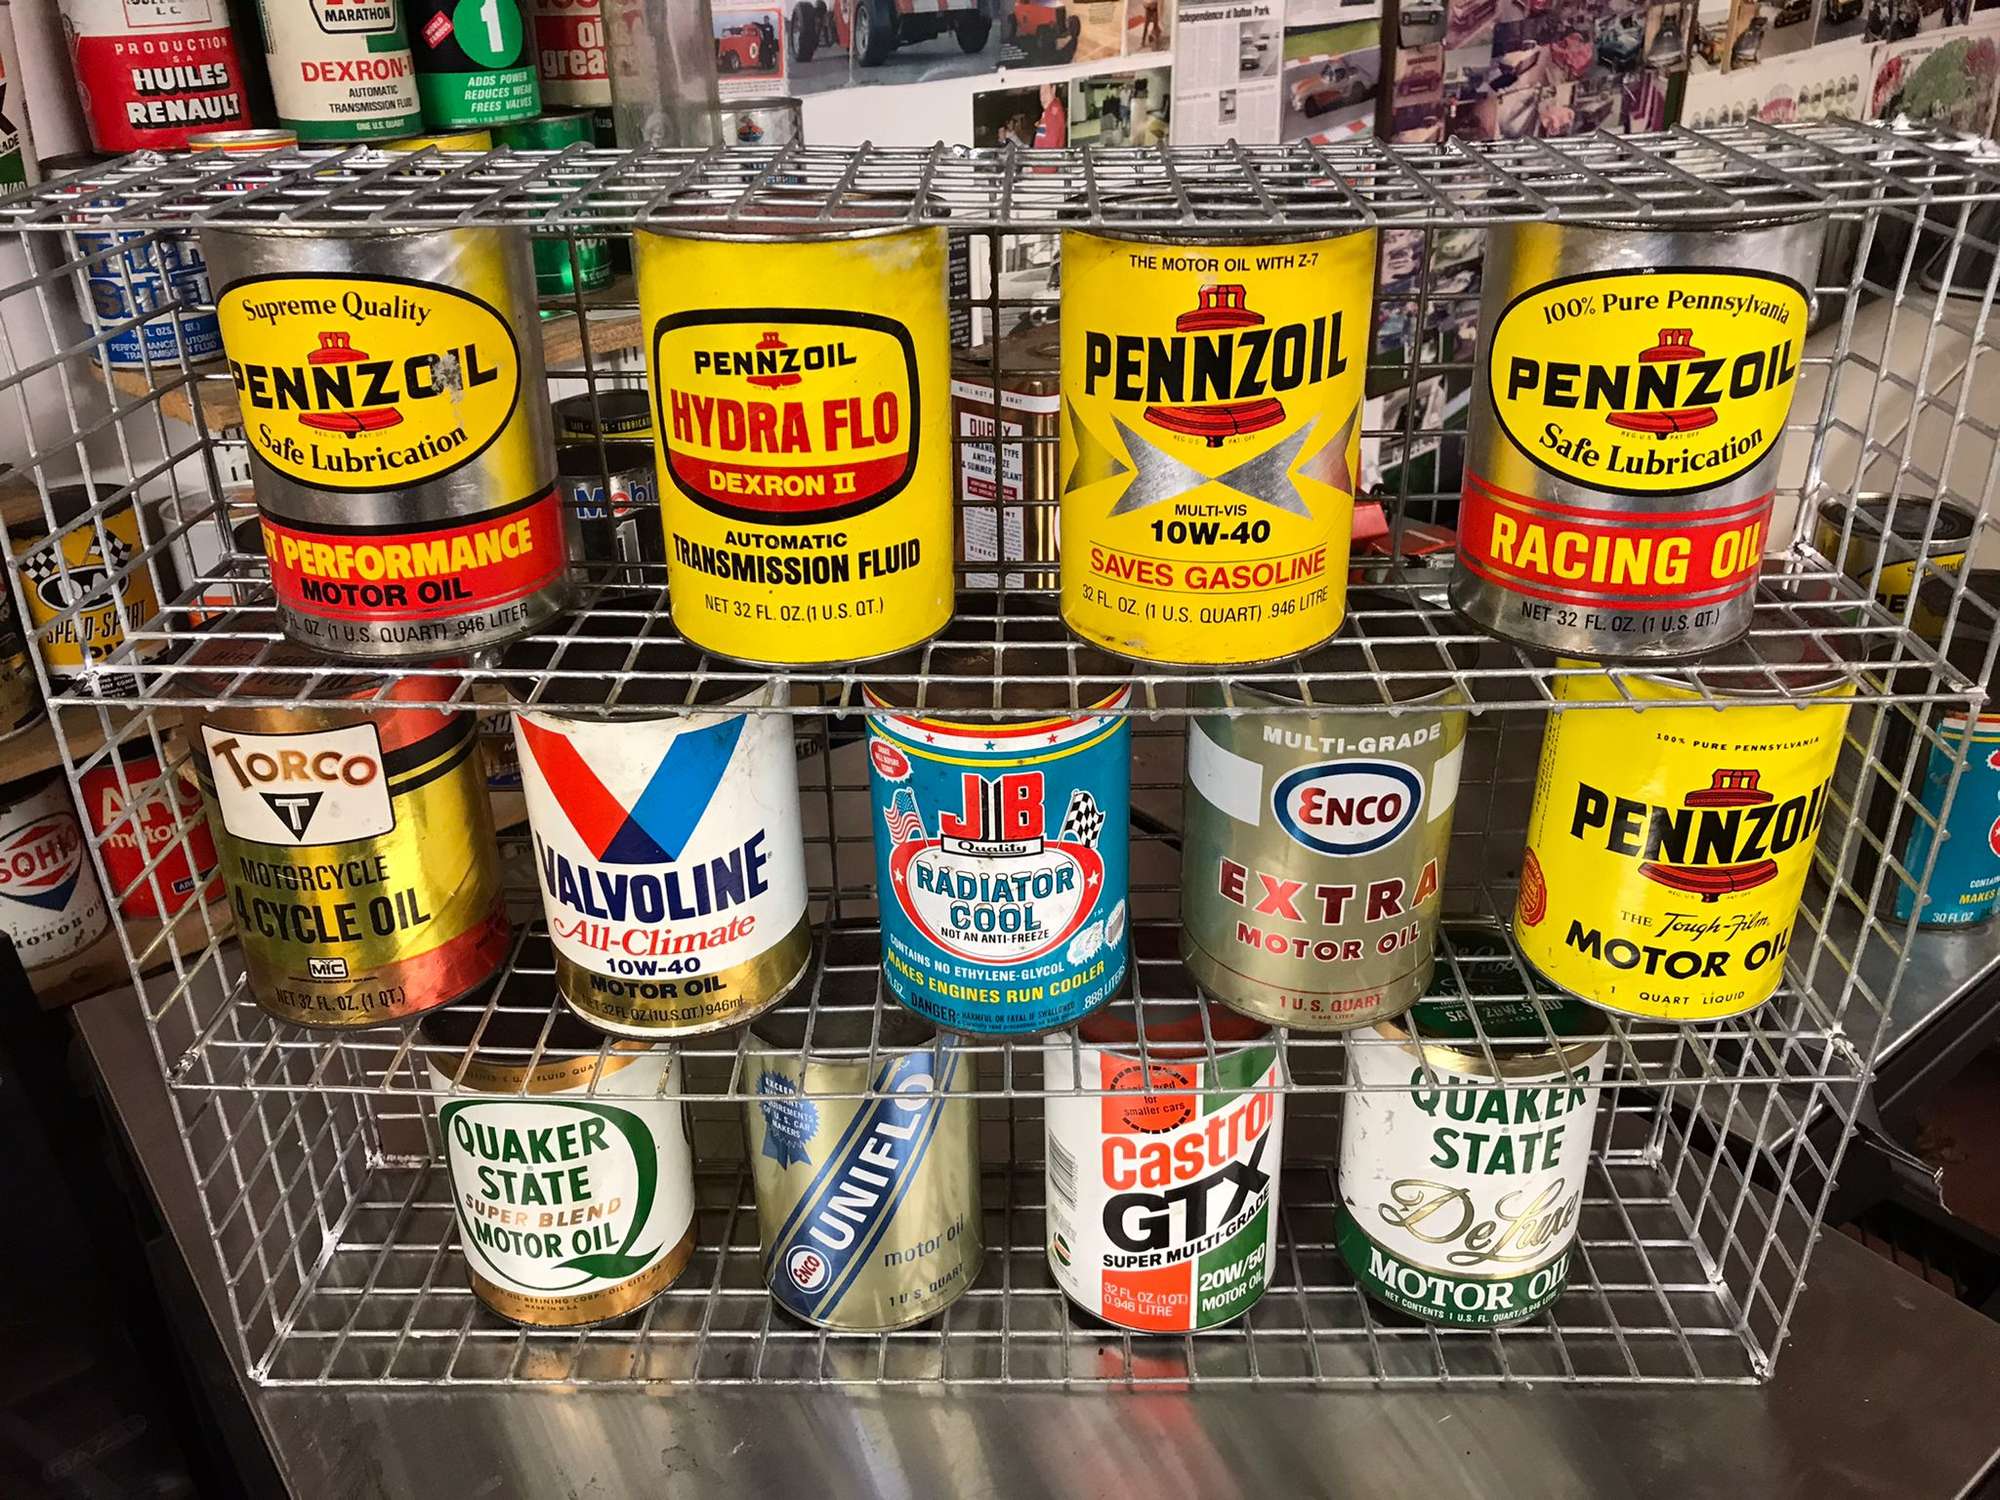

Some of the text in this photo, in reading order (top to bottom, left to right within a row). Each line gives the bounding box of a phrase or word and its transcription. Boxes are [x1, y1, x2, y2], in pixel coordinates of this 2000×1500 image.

[325, 6, 391, 22] MARATHON
[115, 36, 228, 55] PRODUCTION
[131, 62, 228, 93] HUILES
[349, 85, 399, 98] AUTOMATIC
[465, 86, 510, 101] REDUCES
[468, 71, 528, 87] ADDS POWER
[125, 93, 241, 126] RENAULT
[329, 97, 414, 114] TRANSMISSION FLUID
[471, 98, 533, 113] FREES VALVES
[1130, 253, 1319, 271] THE MOTOR OIL WITH Z-7
[243, 291, 432, 327] Supreme Quality
[1543, 289, 1791, 325] 100% Pure Pennsylvania
[694, 342, 858, 376] PENNZOIL
[1085, 311, 1348, 402] PENNZOIL
[1507, 339, 1797, 410] PENNZOIL
[670, 388, 900, 453] HYDRA FLO
[259, 423, 469, 472] Safe Lubrication
[1003, 448, 1020, 460] TYPE
[1538, 422, 1764, 475] Safe Lubrication
[709, 469, 857, 497] DEXRON II
[968, 463, 992, 475] SUMMER
[1175, 504, 1248, 517] MULTI-VIS
[281, 518, 534, 580] PERFORMANCE
[725, 531, 848, 550] AUTOMATIC
[1151, 520, 1271, 545] 10W-40
[1490, 512, 1762, 585] RACING OIL
[673, 533, 921, 585] TRANSMISSION FLUID
[1090, 547, 1327, 590] SAVES GASOLINE
[301, 576, 473, 607] MOTOR OIL
[1200, 585, 1329, 623] QUART) .946 LITRE
[380, 602, 529, 644] QUART) .946 LITER
[1263, 721, 1442, 755] MULTI-GRADE
[1656, 732, 1821, 752] 100% PURE PENNSYLVANIA
[211, 737, 379, 792] TORCO
[1298, 787, 1402, 827] ENCO
[1569, 776, 1832, 865] PENNZOIL
[957, 840, 1028, 857] Quality
[239, 855, 390, 892] MOTORCYCLE
[536, 828, 769, 924] VALVOLINE
[916, 860, 1075, 903] RADIATOR
[1218, 855, 1440, 927] EXTRA
[1958, 889, 1995, 906] MAKES
[252, 899, 362, 944] CYCLE
[369, 888, 431, 937] OIL
[949, 901, 1042, 933] COOL
[1620, 910, 1769, 942] THE Tough-Film
[1932, 911, 1947, 924] 30
[553, 914, 757, 957] All-Climate
[941, 927, 1050, 944] NOT AN ANTI-FREEZE
[1236, 920, 1421, 963] MOTOR OIL
[1565, 918, 1732, 980] MOTOR
[1743, 926, 1789, 972] OIL
[311, 962, 345, 977] MIC
[606, 957, 701, 977] 10W-40
[890, 933, 1065, 982] CONTAINS NO ETHYLENE-GLYCOL
[591, 975, 727, 999] MOTOR OIL
[887, 948, 1105, 1004] MAKES ENGINES RUN COOLER
[911, 991, 961, 1024] DANGER:
[1292, 994, 1382, 1013] U.S. QUART
[1639, 989, 1745, 1006] QUART LIQUID
[537, 1071, 566, 1082] FLUID
[765, 1077, 795, 1095] EXCEED
[1124, 1102, 1186, 1117] smaller cars
[1144, 1096, 1157, 1104] for
[1410, 1065, 1591, 1125] QUAKER
[454, 1114, 609, 1164] QUAKER
[772, 1119, 801, 1139] MAKERS
[794, 1120, 811, 1132] CAR
[1102, 1066, 1275, 1191] Castrol
[808, 1073, 934, 1251] UNIFLO
[1430, 1125, 1566, 1175] STATE
[477, 1165, 592, 1206] STATE
[1103, 1125, 1272, 1253] GTX
[465, 1193, 622, 1228] SUPER BLEND
[1103, 1183, 1270, 1267] SUPER MULTI-GRADE
[473, 1218, 619, 1258] MOTOR OIL
[884, 1212, 964, 1267] motor oil
[793, 1255, 821, 1285] ENCO
[929, 1263, 963, 1293] QUART
[1200, 1243, 1265, 1292] 20W/50
[1368, 1246, 1570, 1311] MOTOR OIL
[523, 1296, 570, 1305] REFINING
[608, 1284, 626, 1295] OIL
[1104, 1293, 1173, 1317] 0.946 LITRE
[1202, 1271, 1264, 1312] MOTOR OIL
[1401, 1298, 1444, 1319] CONTENTS
